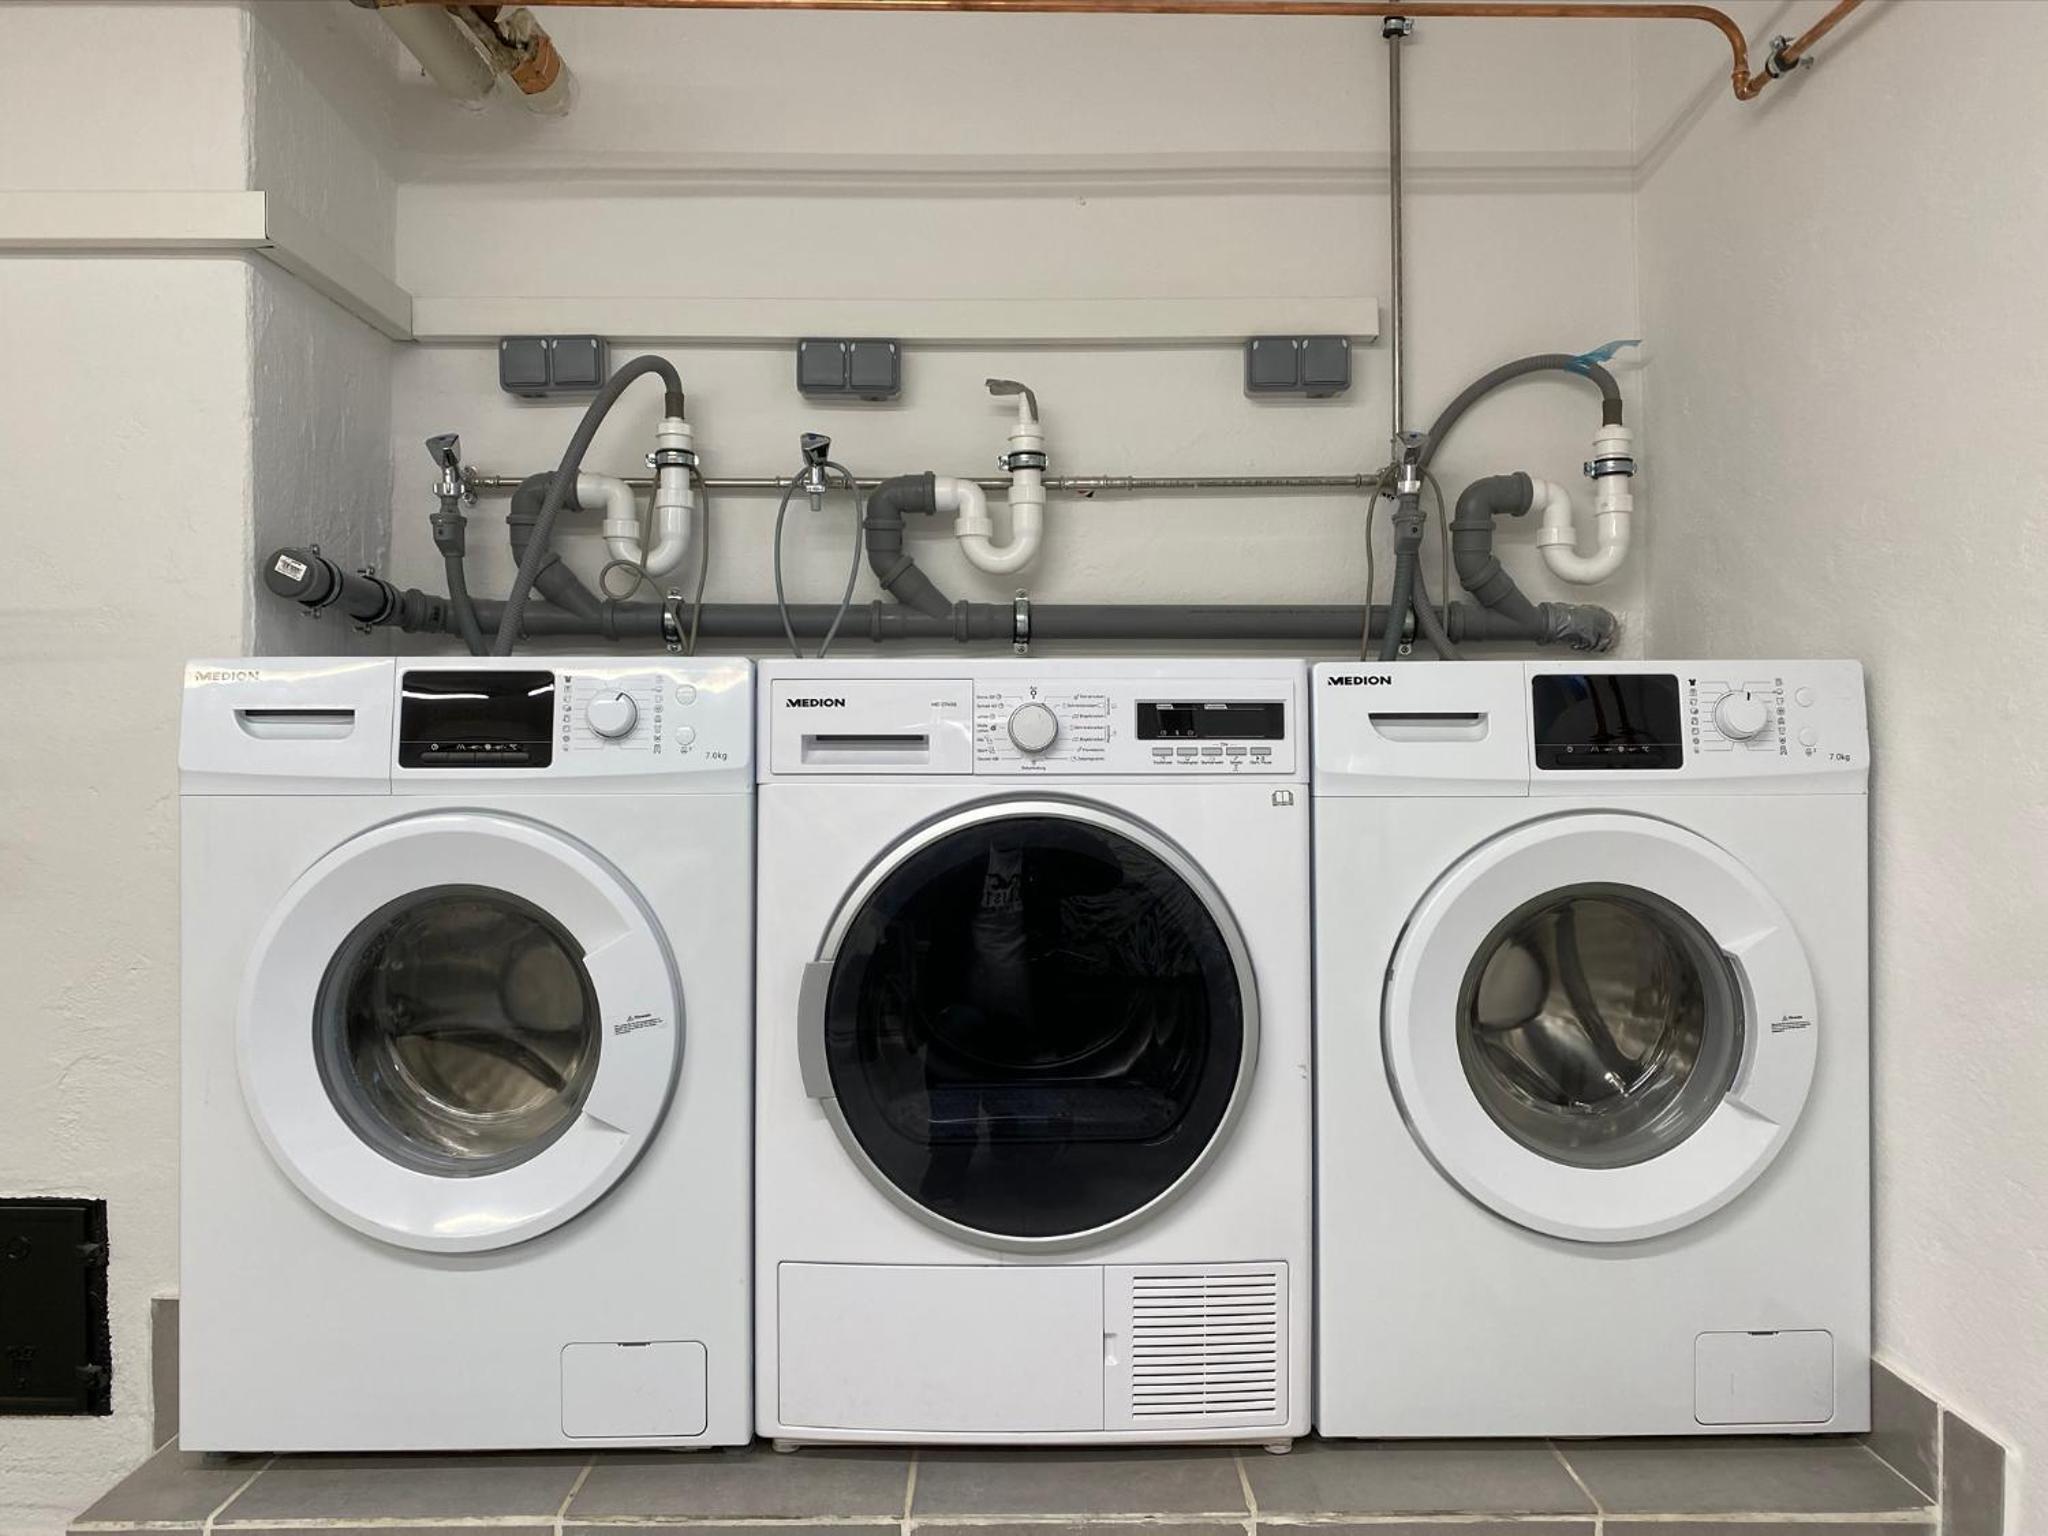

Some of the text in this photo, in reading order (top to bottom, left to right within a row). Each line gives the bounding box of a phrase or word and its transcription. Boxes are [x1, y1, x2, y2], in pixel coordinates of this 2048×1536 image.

[195, 671, 259, 681] MEDION
[1327, 676, 1391, 685] MEDION
[786, 698, 845, 707] MEDION
